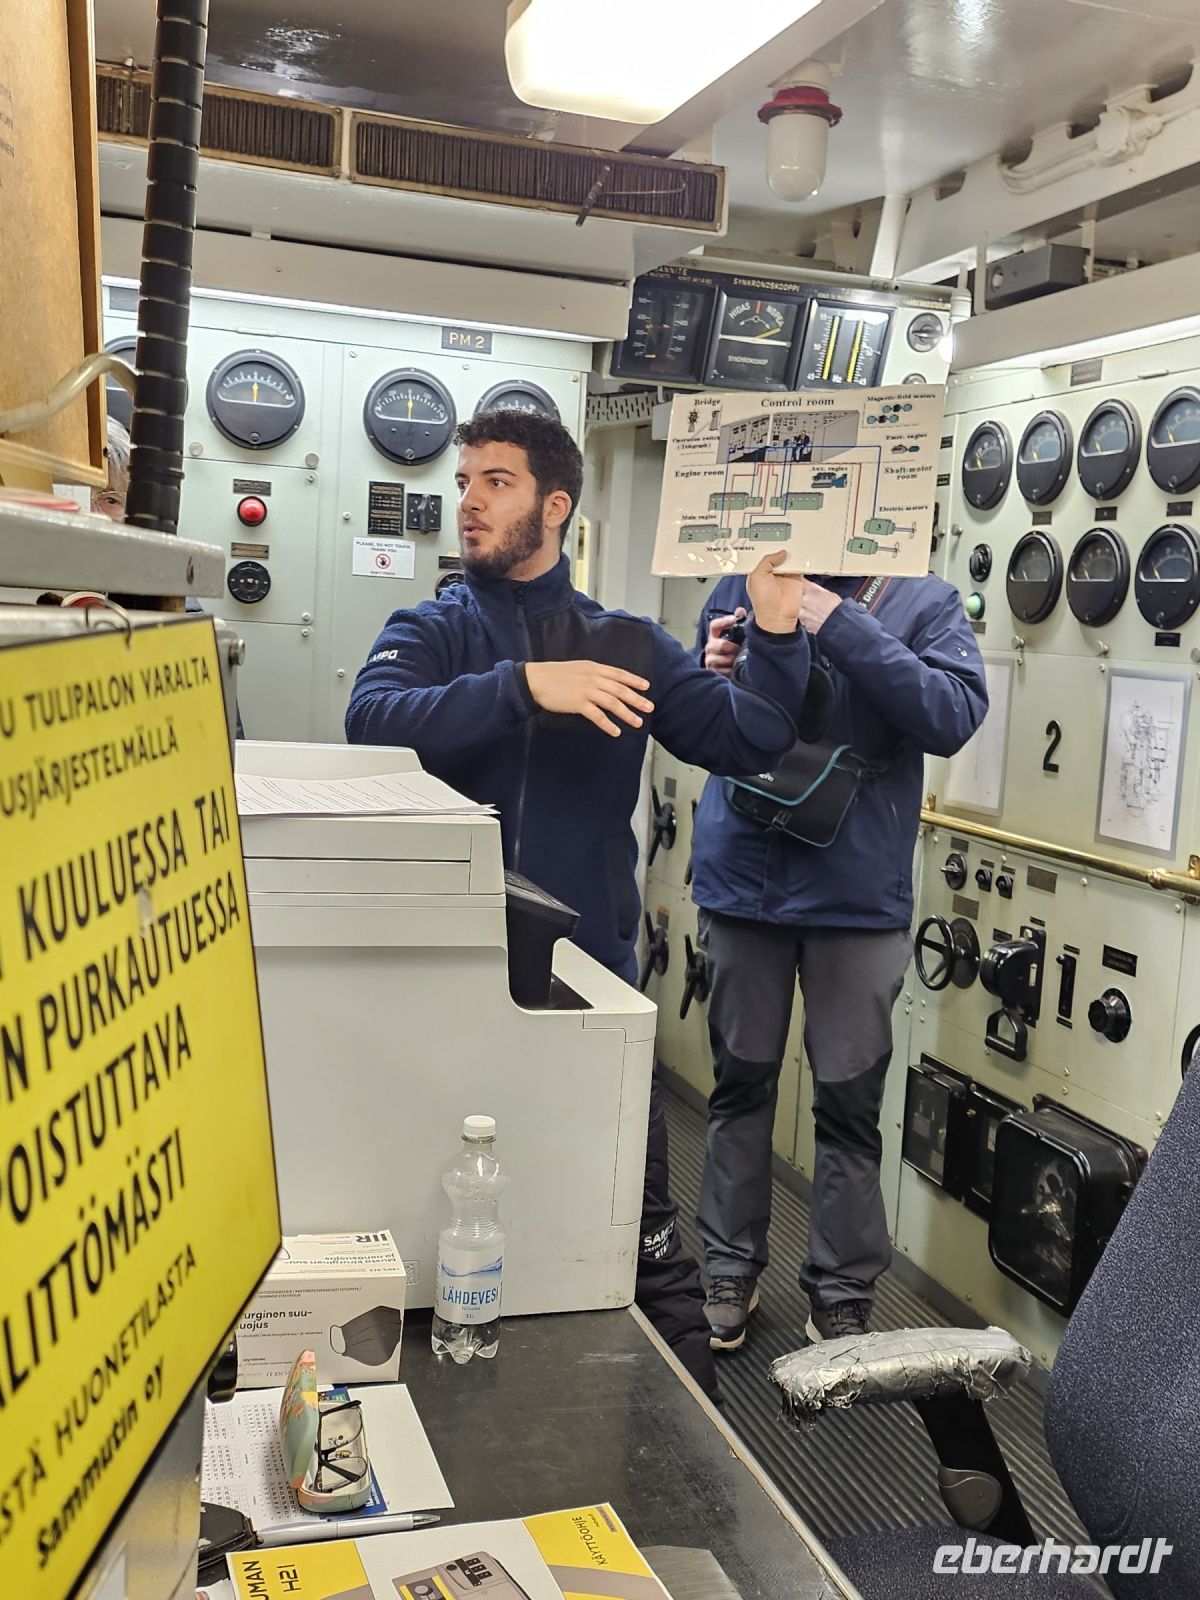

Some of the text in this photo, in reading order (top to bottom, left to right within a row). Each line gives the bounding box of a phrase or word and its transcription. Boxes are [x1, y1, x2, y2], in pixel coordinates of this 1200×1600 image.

[728, 302, 751, 319] HIDAS
[449, 333, 485, 349] PM 2
[694, 398, 720, 406] Bridge
[761, 397, 834, 408] Control room
[675, 470, 702, 478] Engine
[884, 465, 933, 475] Shaft-motor
[24, 669, 136, 732] TULIPALON
[140, 656, 212, 699] VARALTA
[1043, 719, 1062, 773] 2
[0, 715, 180, 822] USJÄRJESTELMÄLLÄ
[17, 786, 231, 962] KUULUESSA TAI
[38, 871, 241, 1072] PURKAUTUESSA
[7, 1003, 192, 1225] OISTUTTAVA
[355, 1233, 388, 1244] IIR
[0, 1126, 185, 1409] LITTÖMÄSTI
[442, 1285, 499, 1306] LÄHDEVESI
[243, 1310, 313, 1322] urginen suu-
[0, 1243, 197, 1545] STÄ HUONETILASTA
[572, 1516, 608, 1565] KÄYTTÖOHJE
